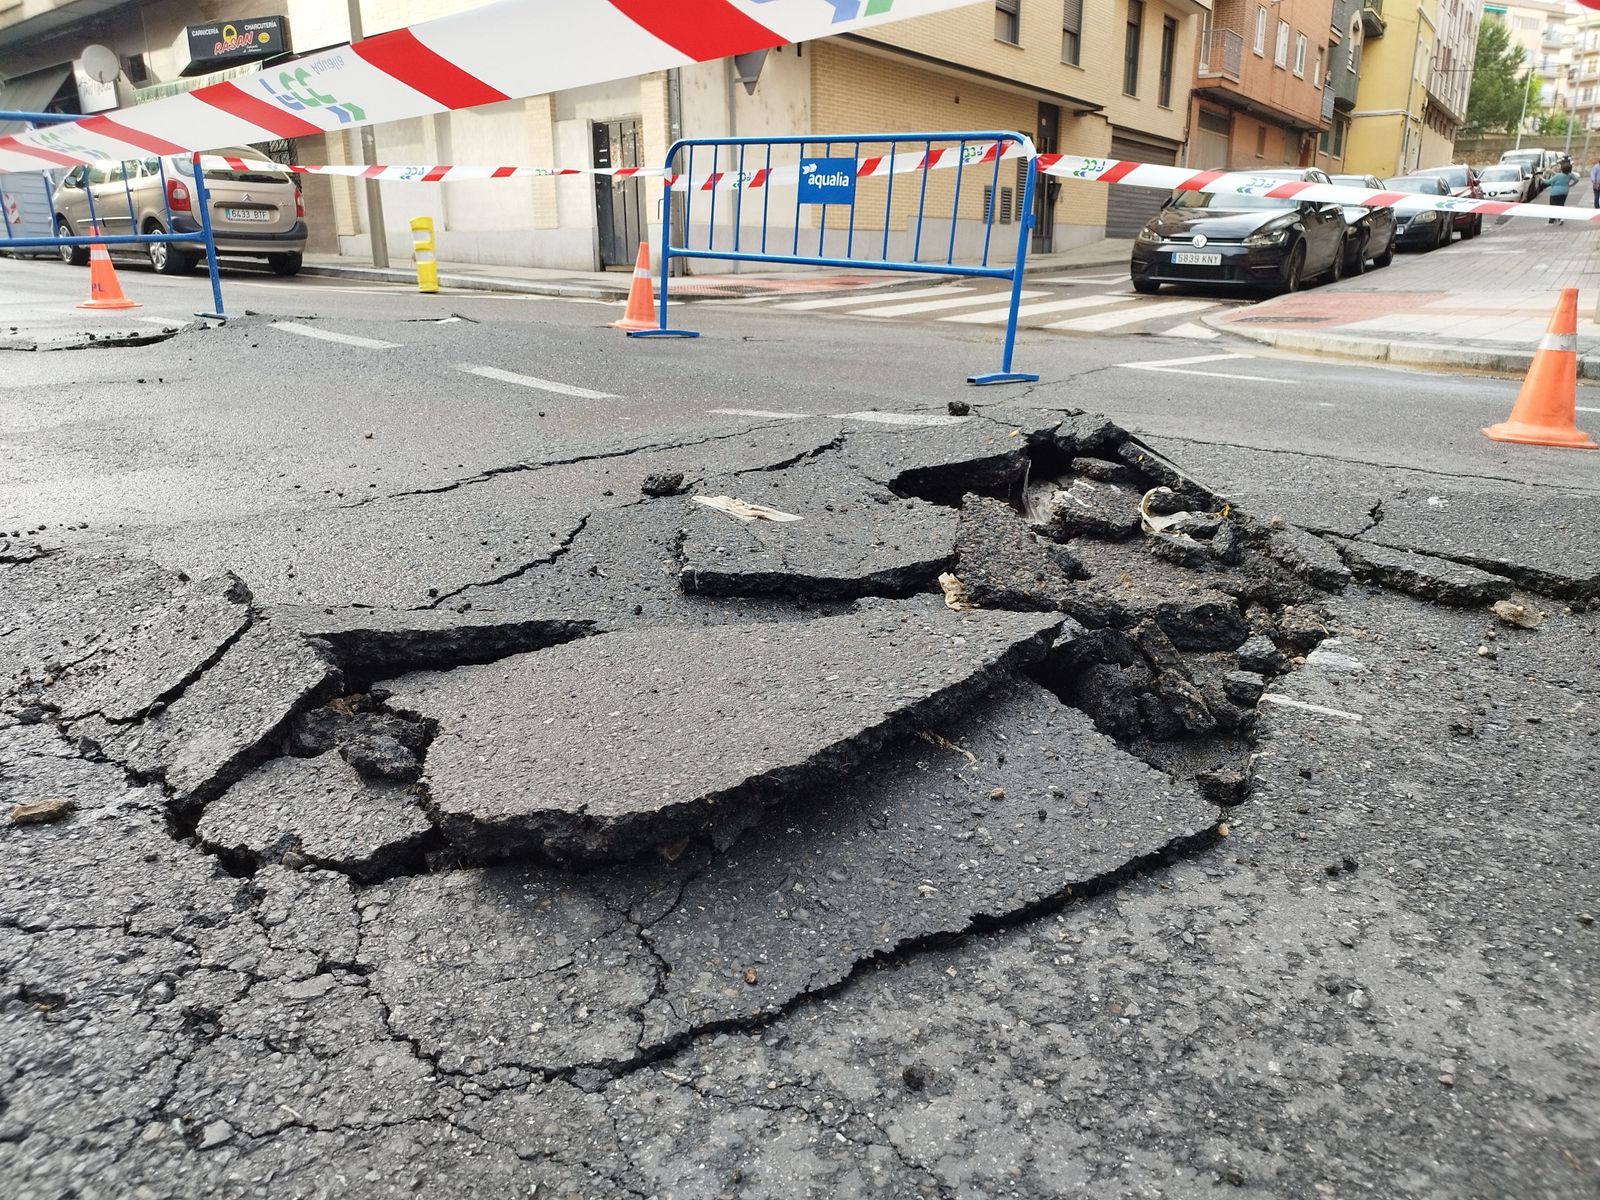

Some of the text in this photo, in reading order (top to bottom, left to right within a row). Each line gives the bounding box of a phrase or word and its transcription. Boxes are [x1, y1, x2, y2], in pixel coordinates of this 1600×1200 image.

[244, 21, 277, 31] CHARCUTERÍA
[192, 27, 219, 37] CARNICERÍA
[213, 31, 254, 56] RASAN
[808, 171, 850, 190] aqualia
[231, 210, 251, 219] 6433
[1177, 254, 1219, 264] 5839 KNY
